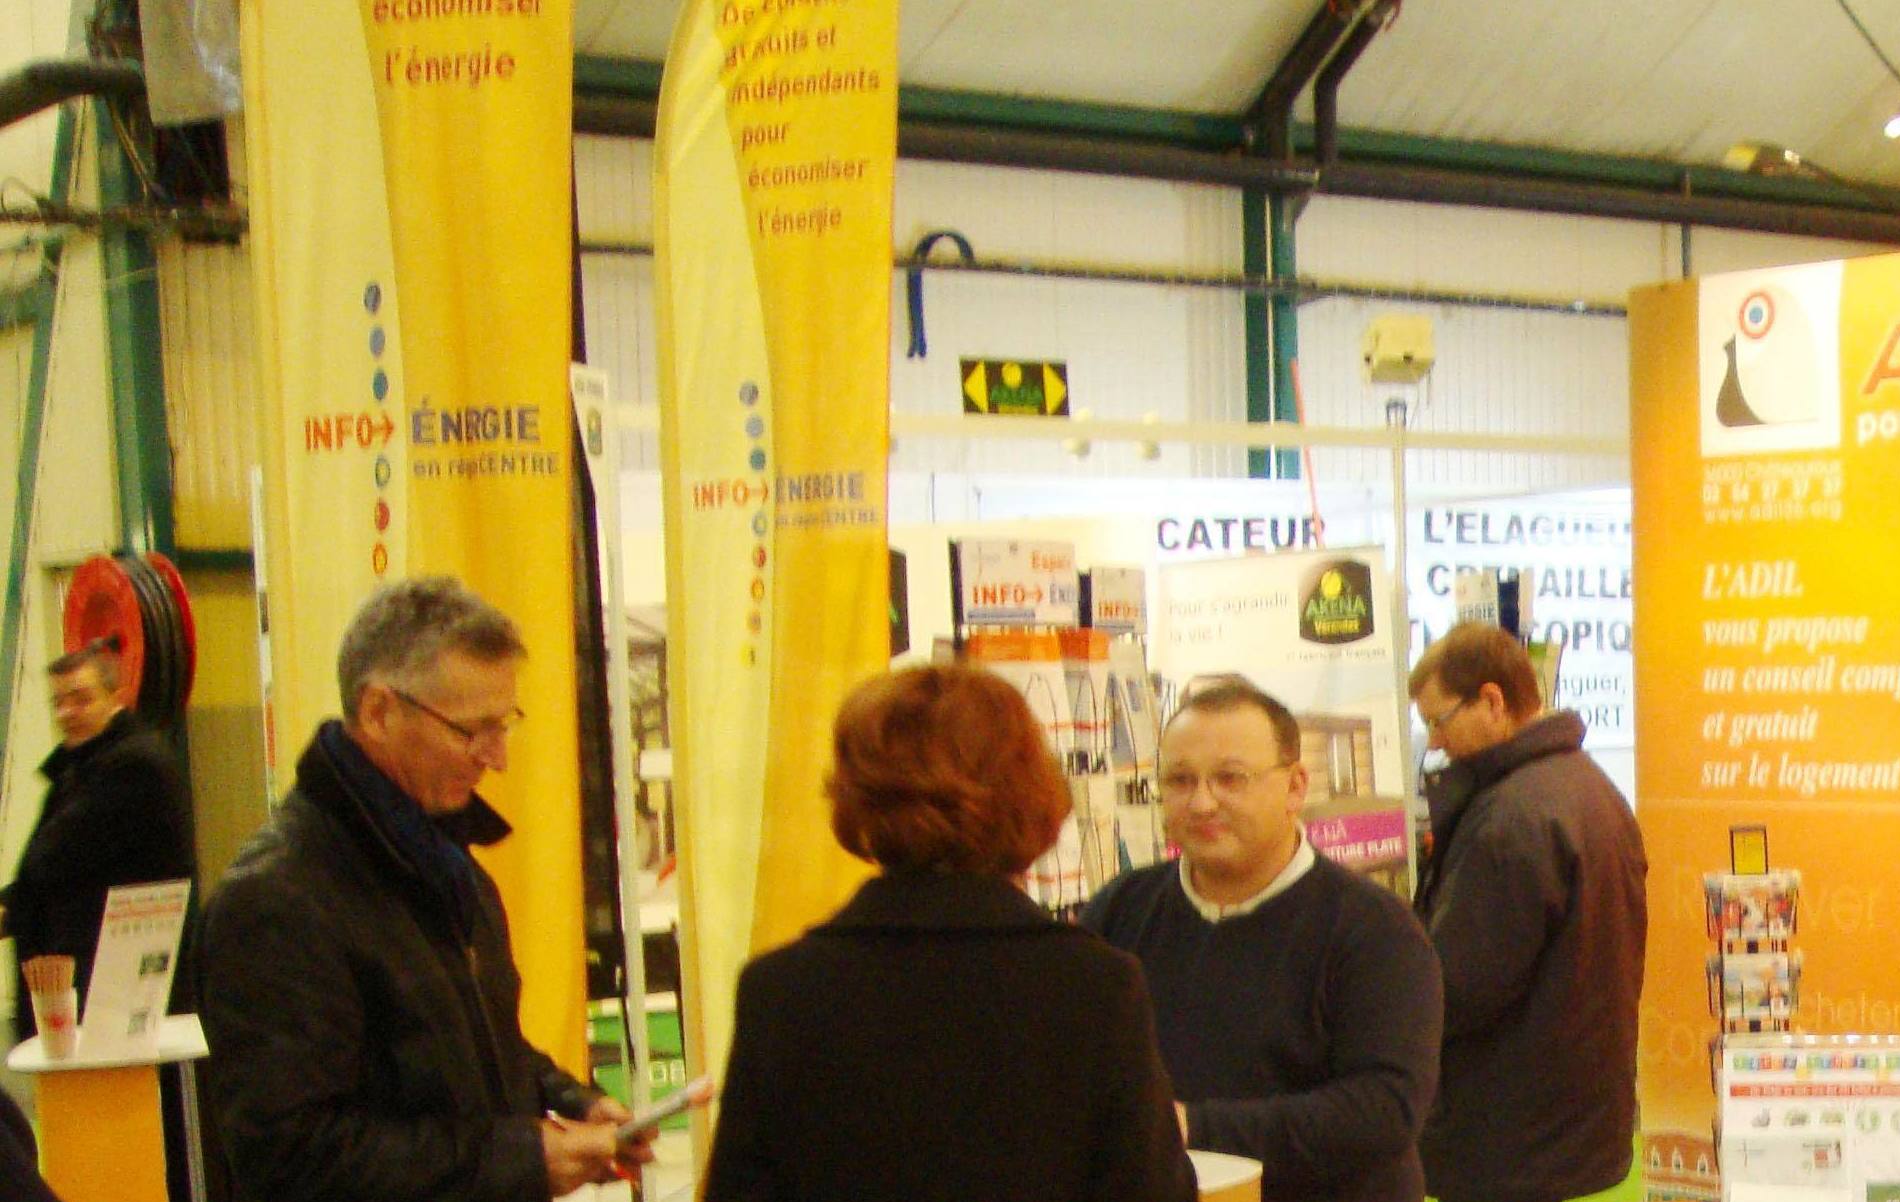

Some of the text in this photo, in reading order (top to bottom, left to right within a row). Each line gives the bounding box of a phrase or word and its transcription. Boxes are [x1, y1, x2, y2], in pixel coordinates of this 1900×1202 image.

[742, 123, 789, 153] pour
[748, 157, 869, 188] économiser
[304, 412, 374, 451] INFO
[693, 478, 749, 511] INFO
[1157, 516, 1327, 551] CATEUR
[972, 583, 1026, 608] INFO
[1702, 560, 1805, 600] L'ADIL
[1703, 615, 1870, 655] vous propose
[1703, 666, 1736, 693] un
[1742, 654, 1837, 693] conseil
[1703, 703, 1819, 748] et gratuit
[1702, 758, 1743, 787] sur
[1748, 751, 1771, 787] le
